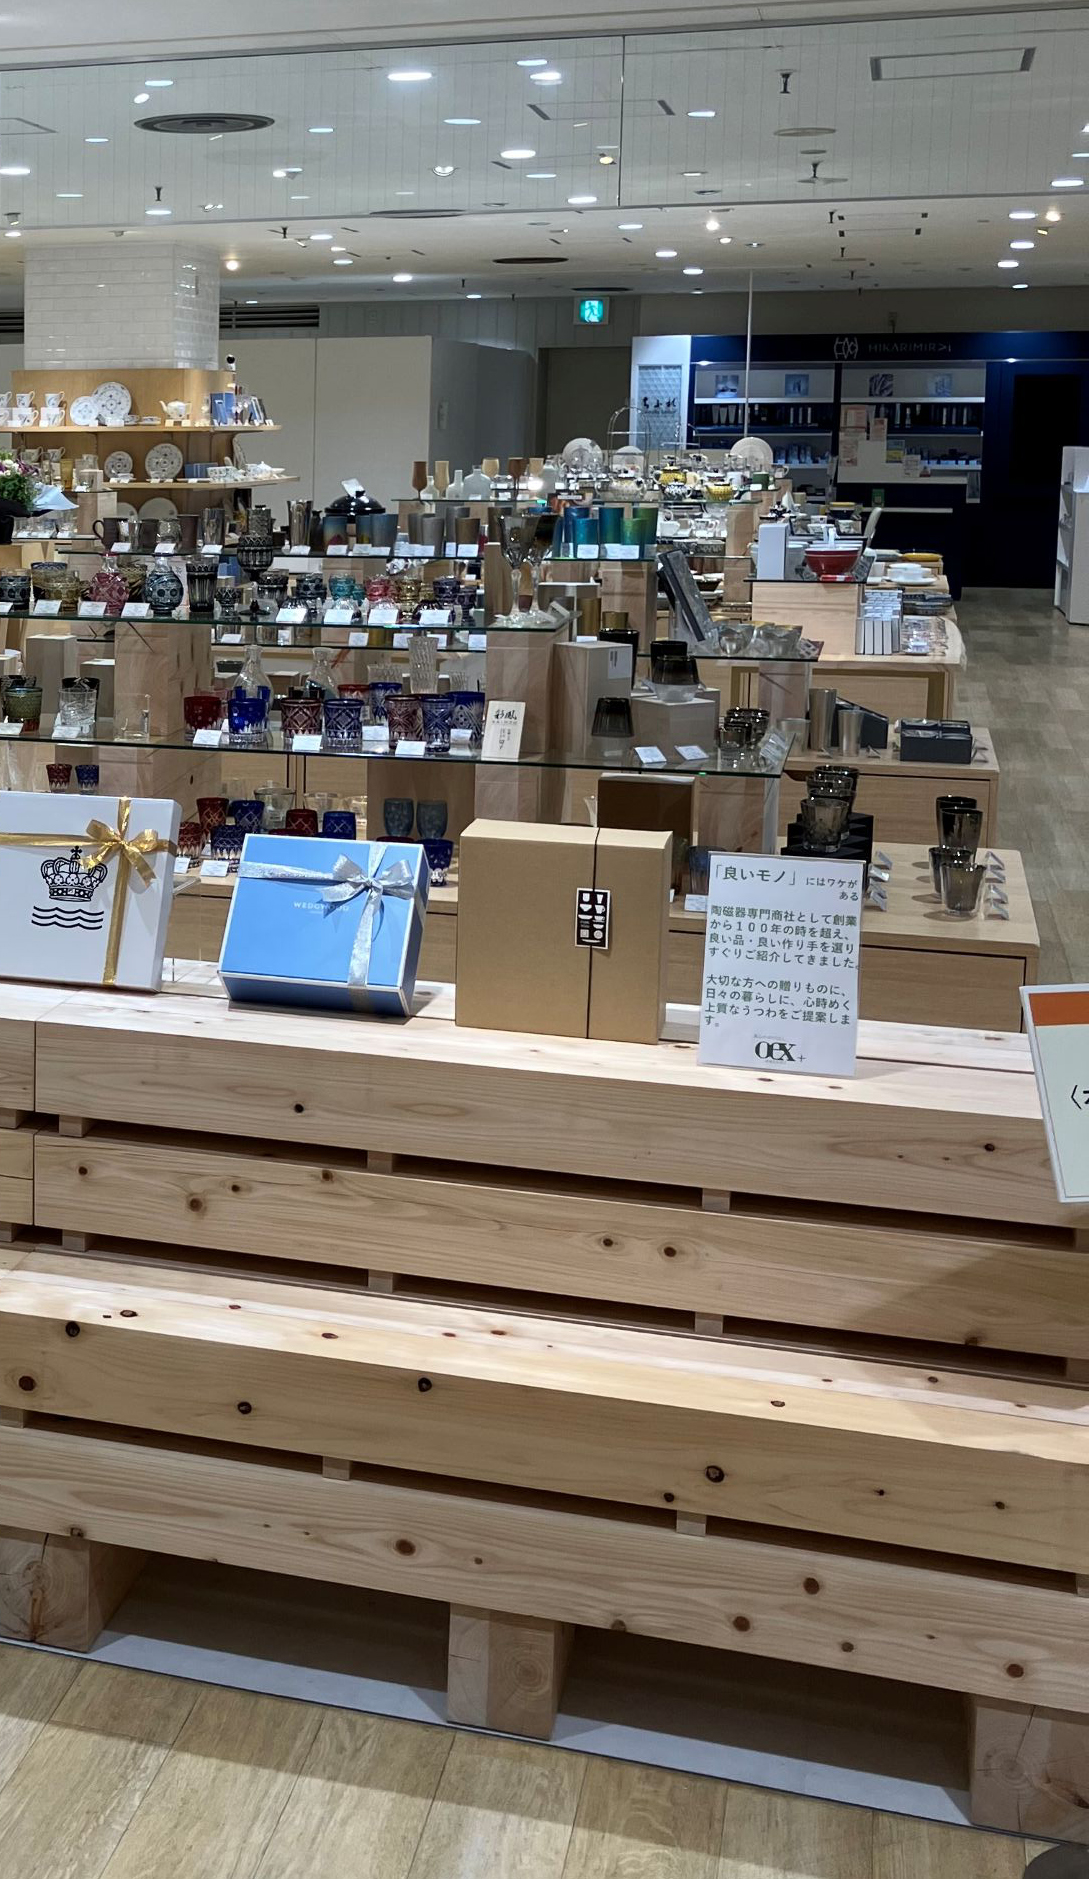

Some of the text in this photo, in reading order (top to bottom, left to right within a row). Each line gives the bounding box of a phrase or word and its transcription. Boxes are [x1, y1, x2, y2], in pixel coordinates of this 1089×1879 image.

[715, 864, 858, 889] 「良いモノ」 にはワケが
[839, 892, 859, 901] ある
[711, 905, 857, 927] 陶磁器専門商社として創業
[709, 932, 854, 954] 良い品・良い作り手を選り
[708, 946, 863, 971] すぐりご紹介してきました。
[706, 973, 846, 997] 大切な方への贈りものに、
[705, 988, 850, 1011] 日々の暮らしに、心時めく
[704, 1002, 850, 1025] 上質なうつわをご提案しま
[704, 1015, 719, 1027] す。
